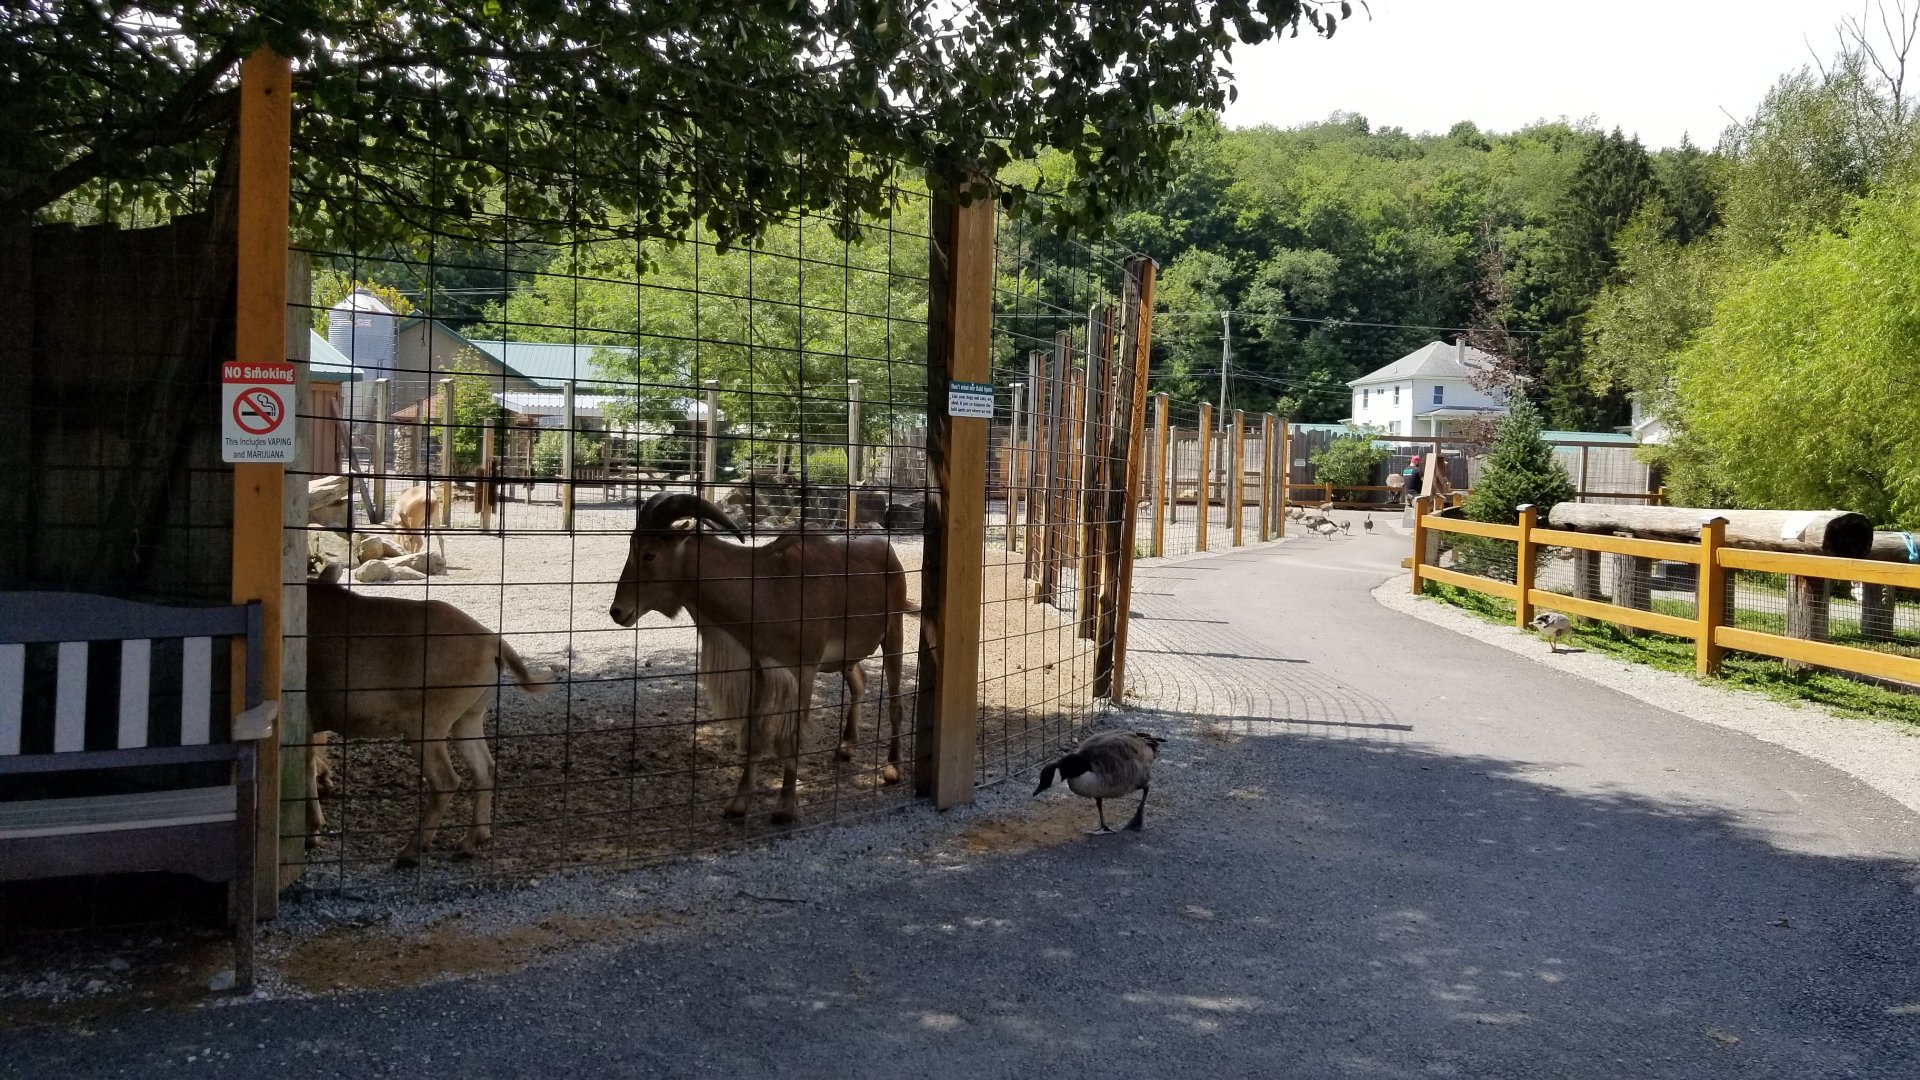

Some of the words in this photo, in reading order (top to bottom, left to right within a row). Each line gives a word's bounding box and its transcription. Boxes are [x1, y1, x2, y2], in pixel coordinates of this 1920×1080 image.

[224, 366, 242, 379] NO
[244, 366, 294, 382] Smoking
[225, 437, 239, 446] This
[267, 437, 292, 446] VAPING
[233, 450, 245, 459] and
[246, 450, 285, 459] MARIJUANA
